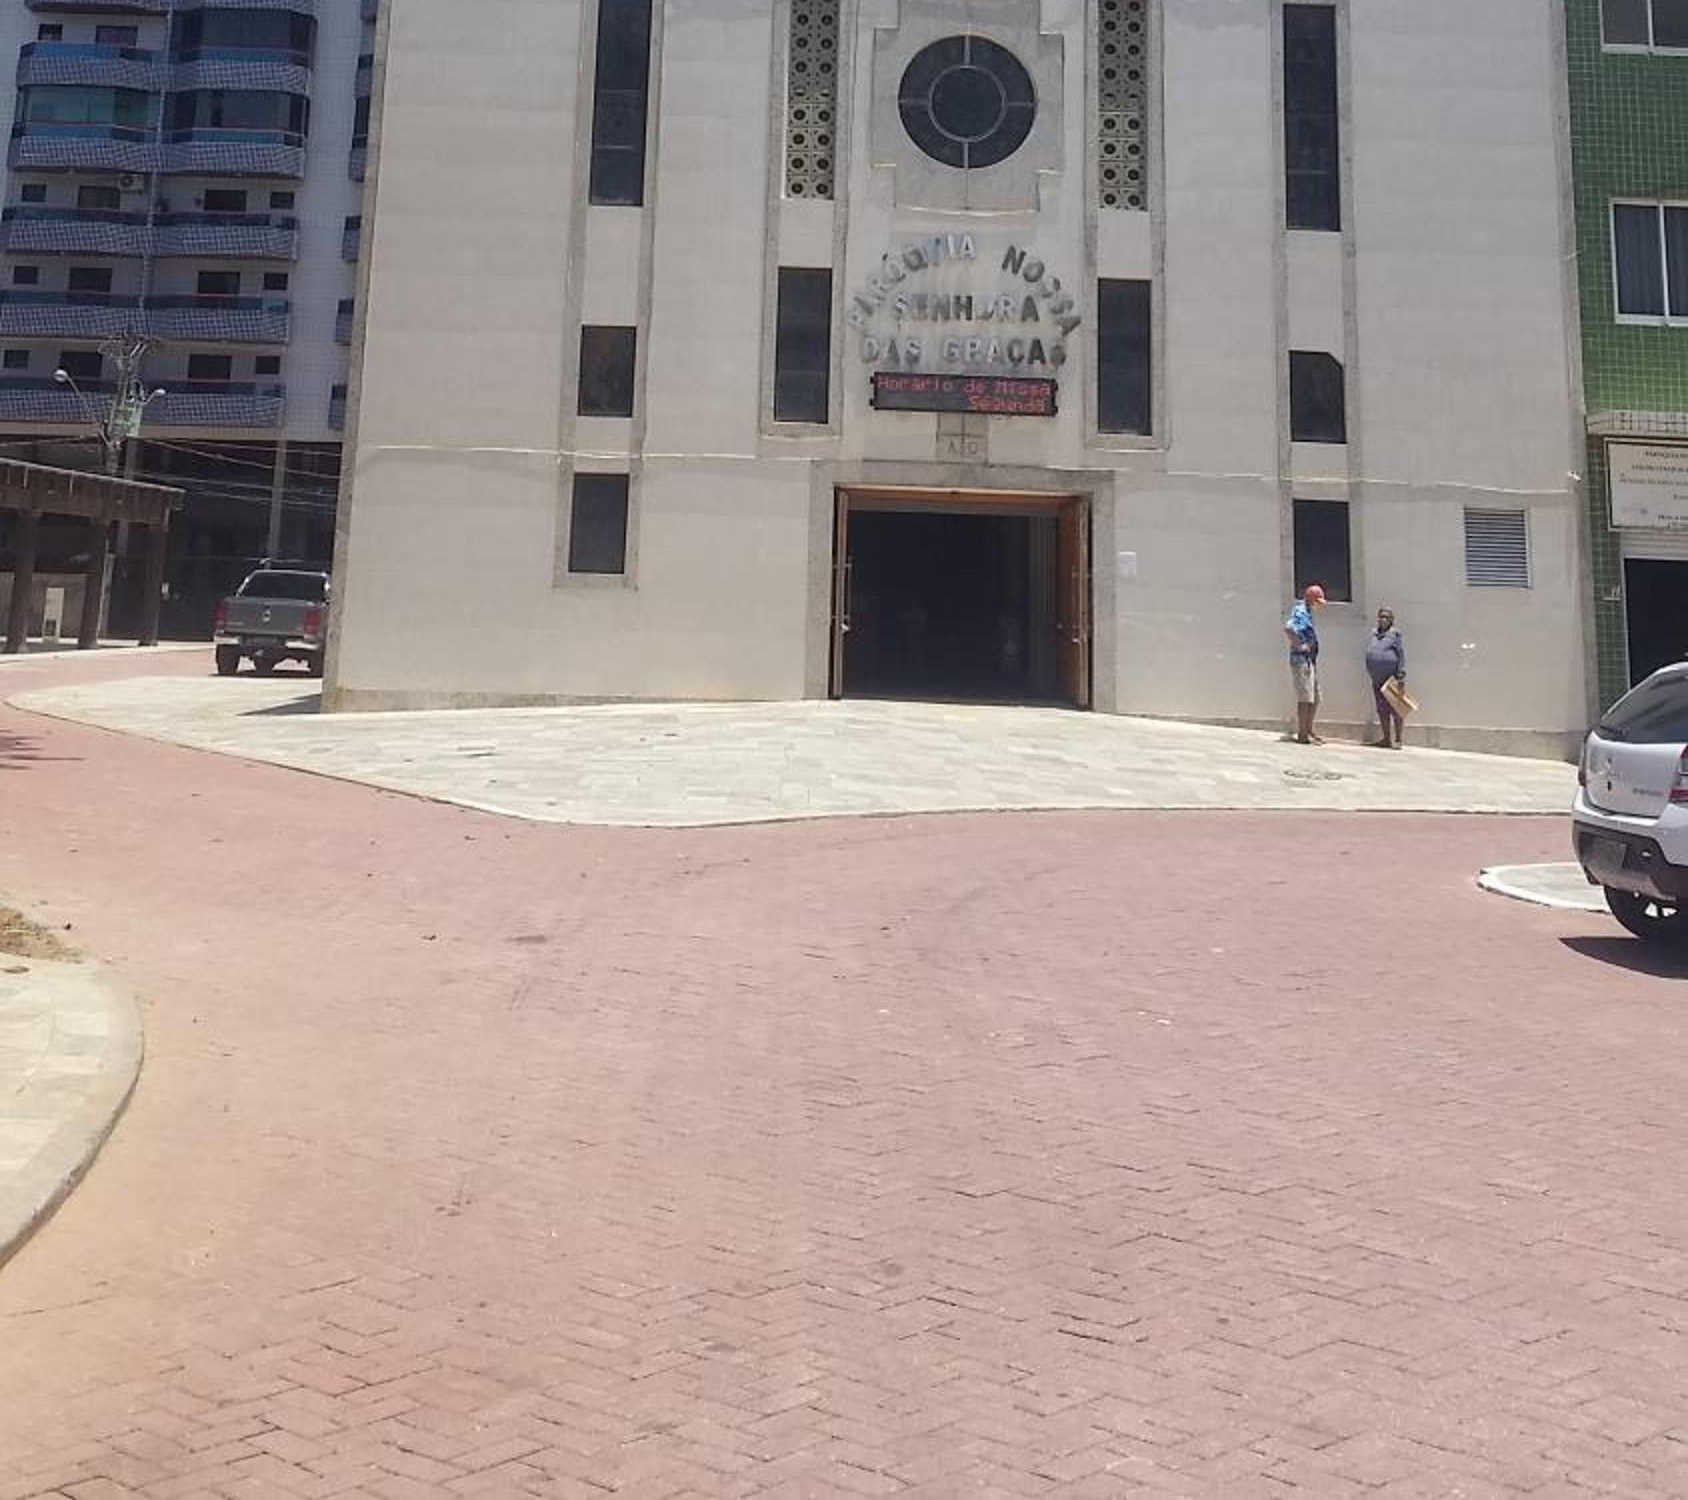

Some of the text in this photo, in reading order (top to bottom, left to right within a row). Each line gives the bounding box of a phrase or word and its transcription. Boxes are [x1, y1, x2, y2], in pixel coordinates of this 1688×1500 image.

[1002, 245, 1082, 337] NOSSA
[895, 294, 1040, 322] SENHORA
[861, 335, 922, 366] DAS
[964, 378, 985, 394] de
